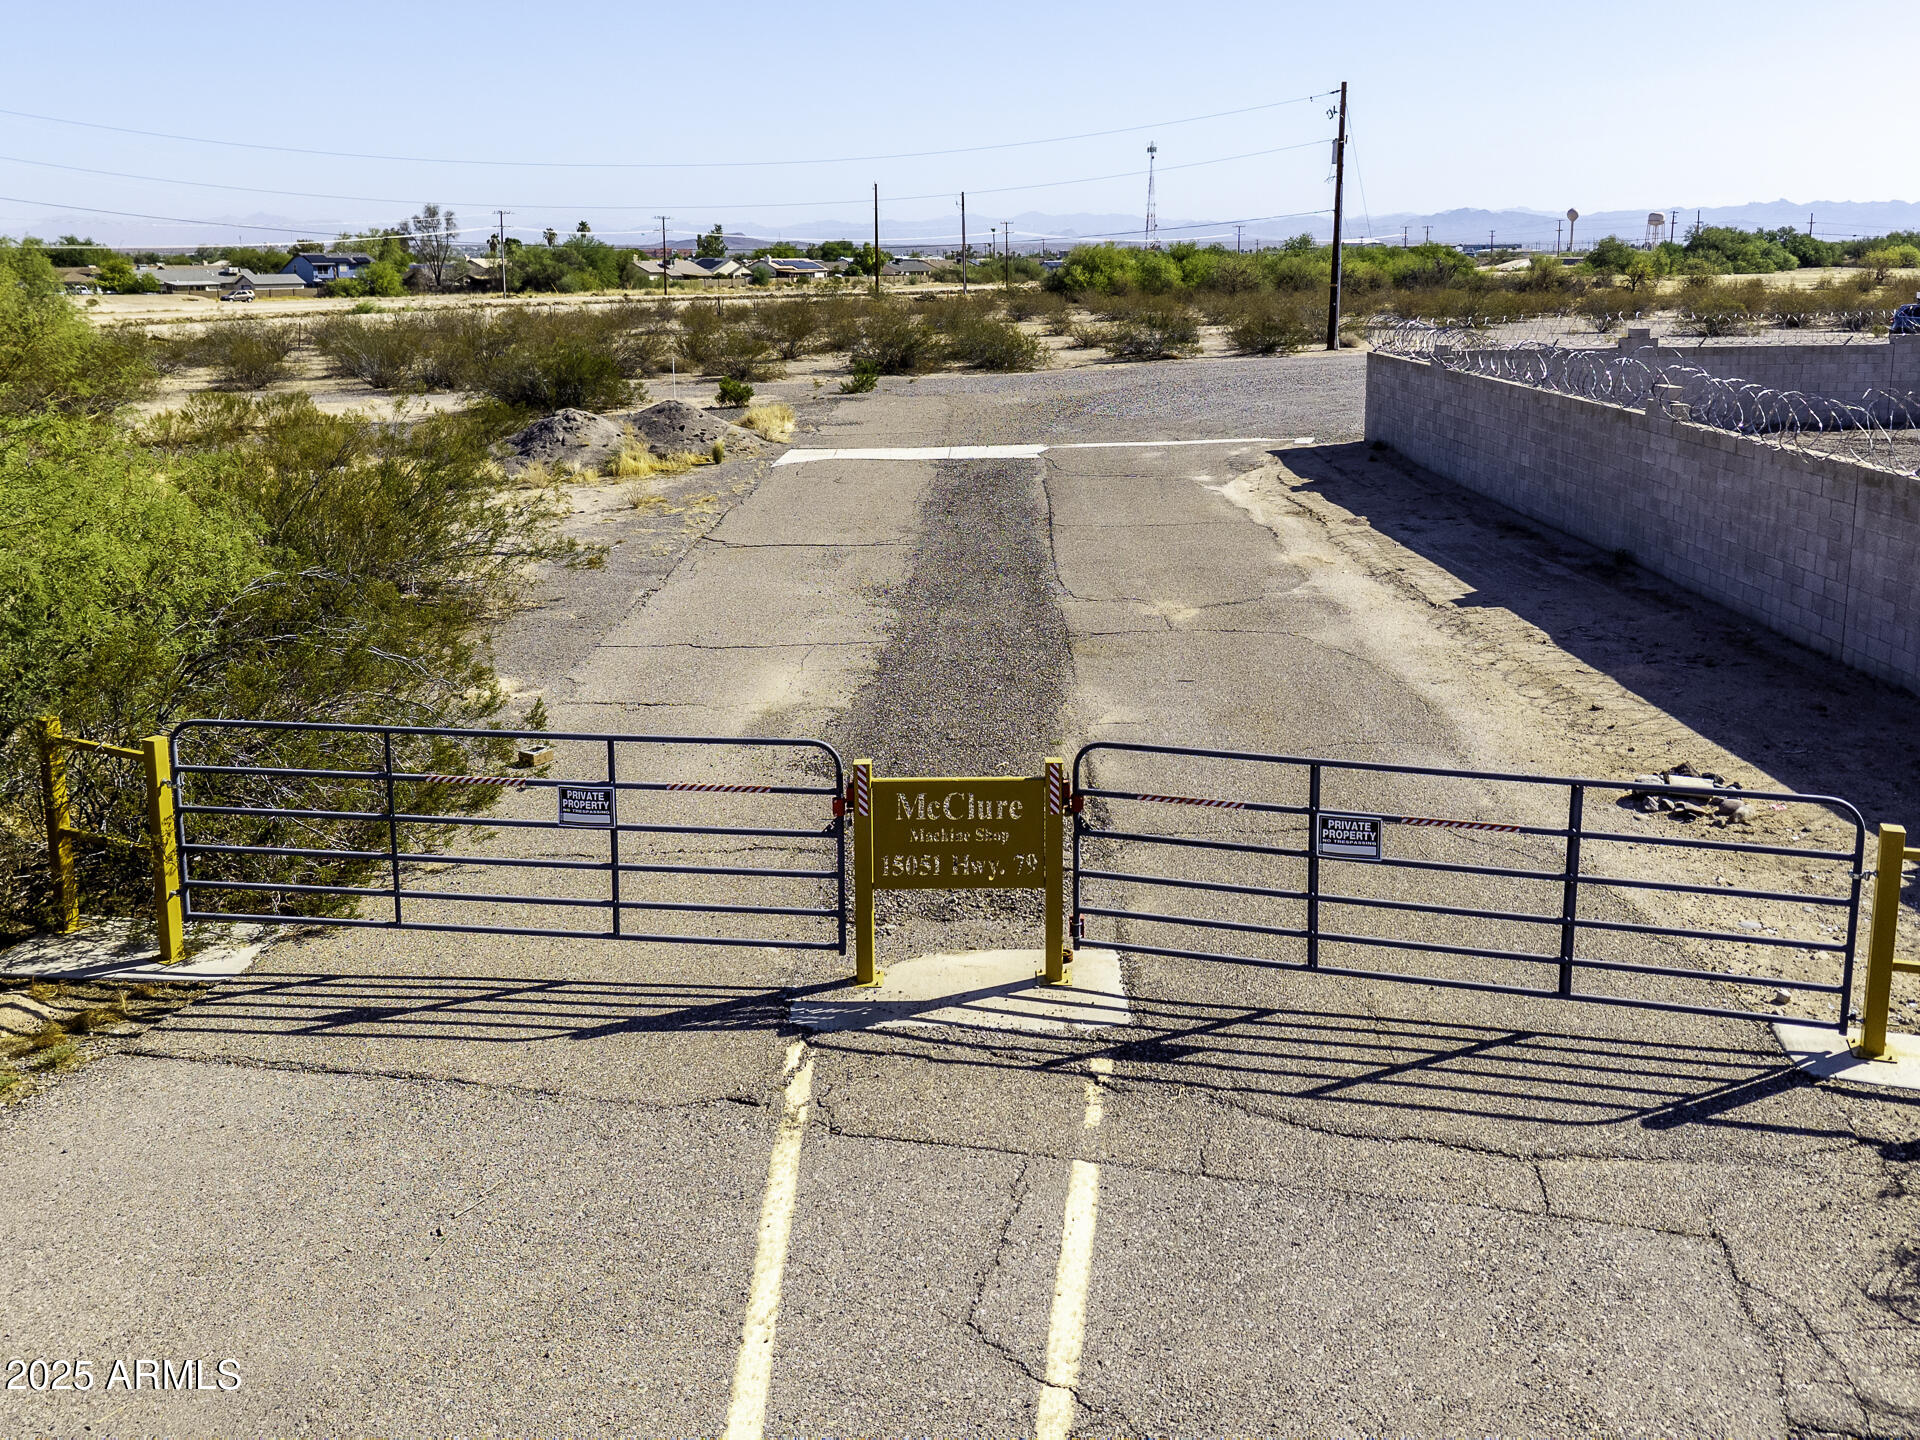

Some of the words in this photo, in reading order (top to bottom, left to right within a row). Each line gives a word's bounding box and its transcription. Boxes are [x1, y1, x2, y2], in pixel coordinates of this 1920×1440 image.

[567, 790, 604, 800] PRIVATE
[562, 799, 609, 809] PROPERTY
[895, 792, 1024, 821] McClure
[1328, 820, 1371, 831] PRIVATE
[909, 828, 971, 843] Machine
[975, 828, 1010, 844] Shop
[1322, 829, 1376, 840] PROPERTY
[881, 854, 940, 876] 15051
[951, 854, 1006, 881] Hwy.
[1013, 853, 1038, 875] 79
